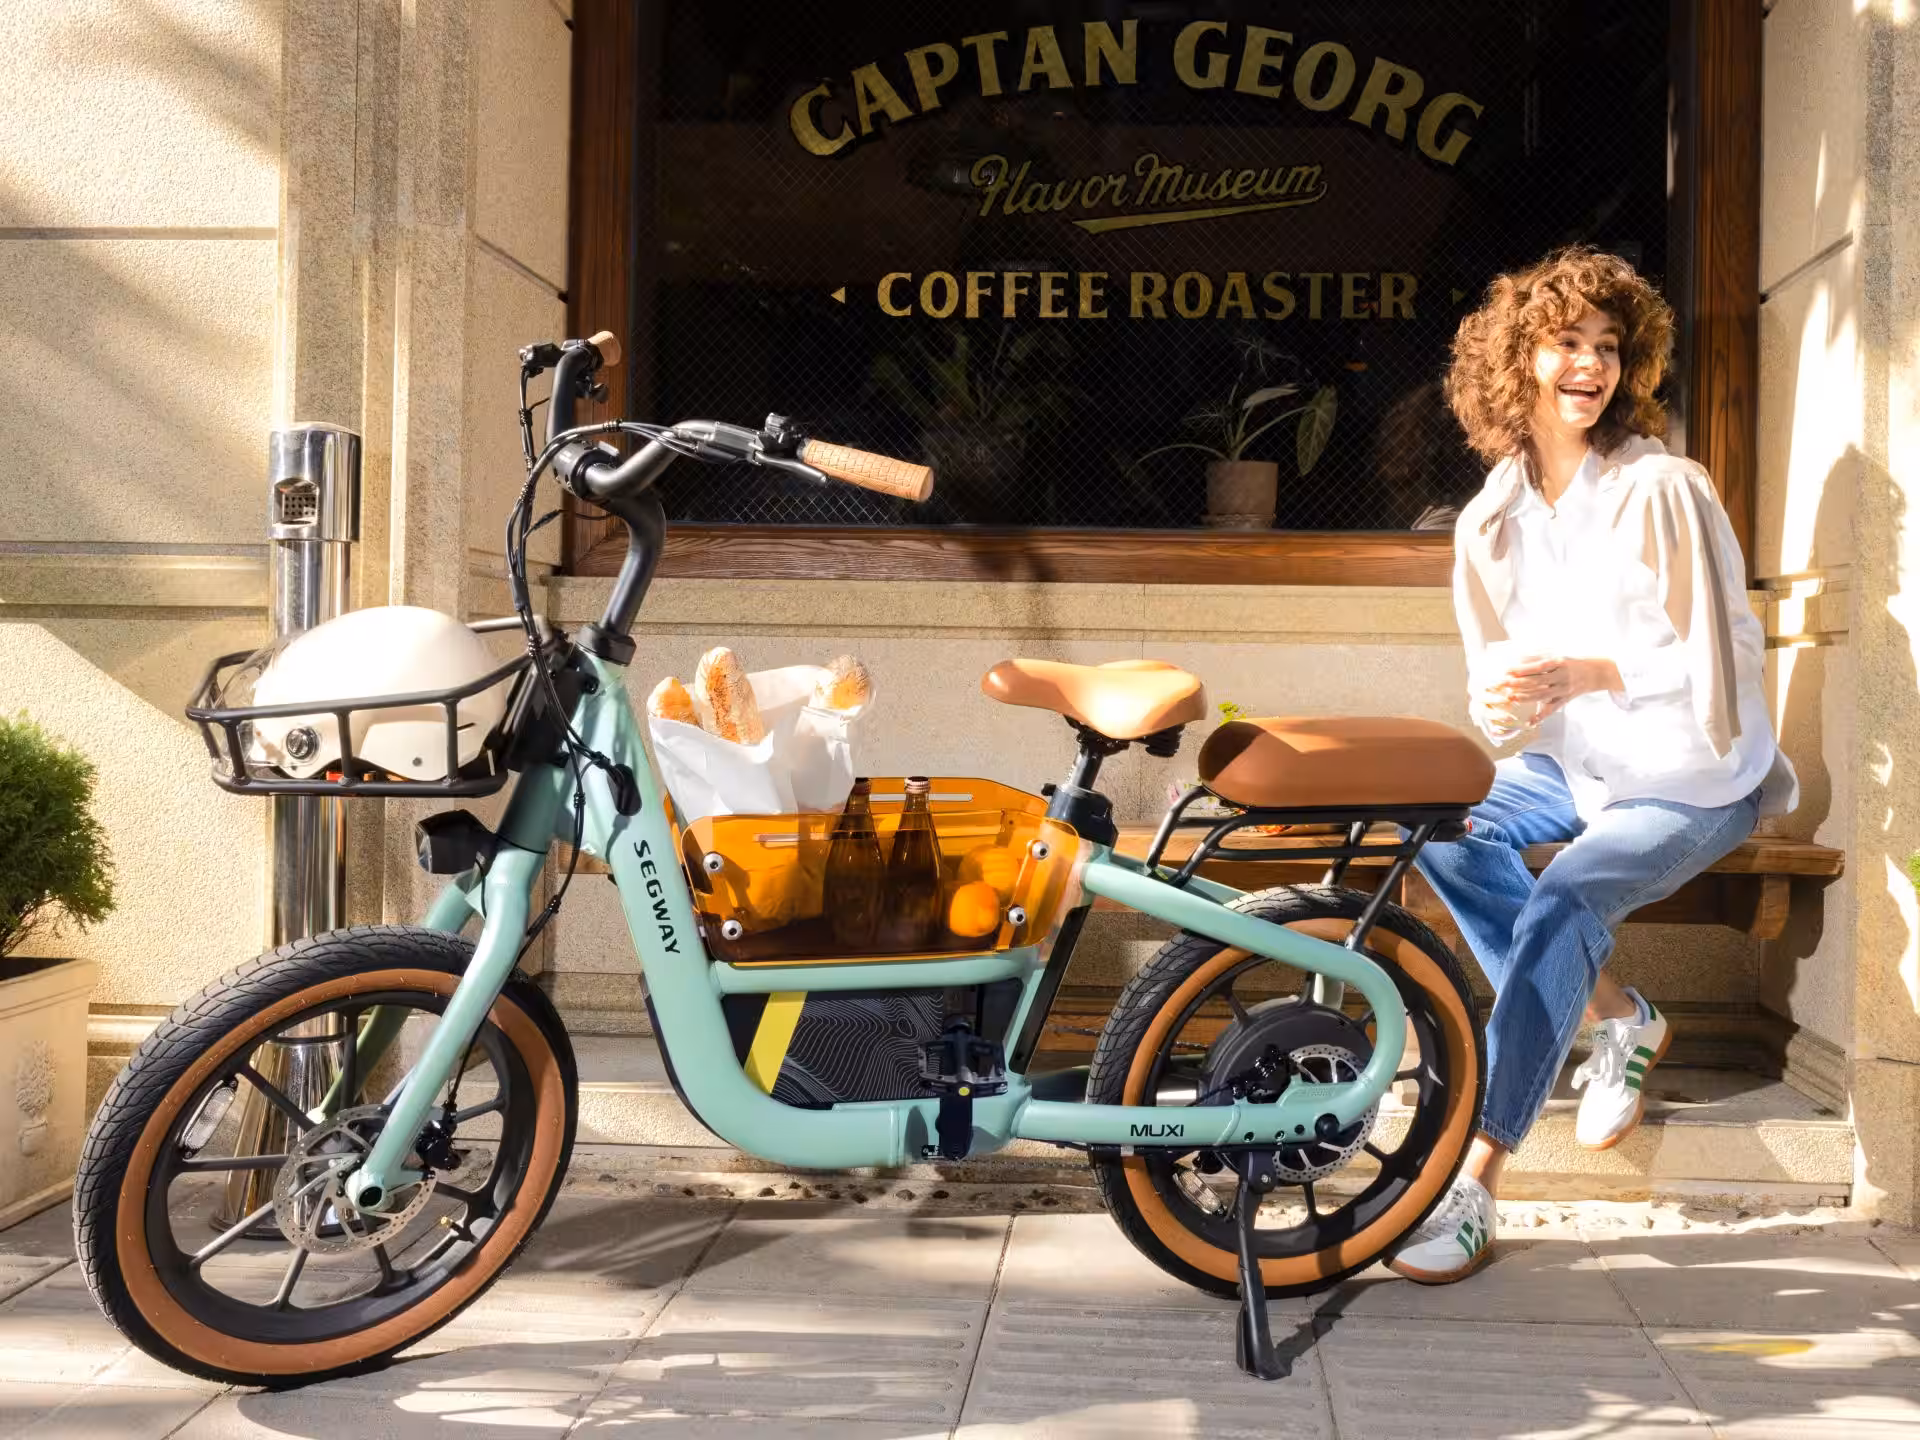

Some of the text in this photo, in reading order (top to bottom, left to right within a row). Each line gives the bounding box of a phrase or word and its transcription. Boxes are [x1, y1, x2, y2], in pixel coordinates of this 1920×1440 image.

[789, 19, 1484, 165] CAPTAN GEORG
[970, 153, 1328, 216] Flavor Museum
[876, 270, 1417, 320] COFFEE ROASTER
[633, 839, 681, 954] SEGWAY
[1130, 1124, 1185, 1137] MUXI
